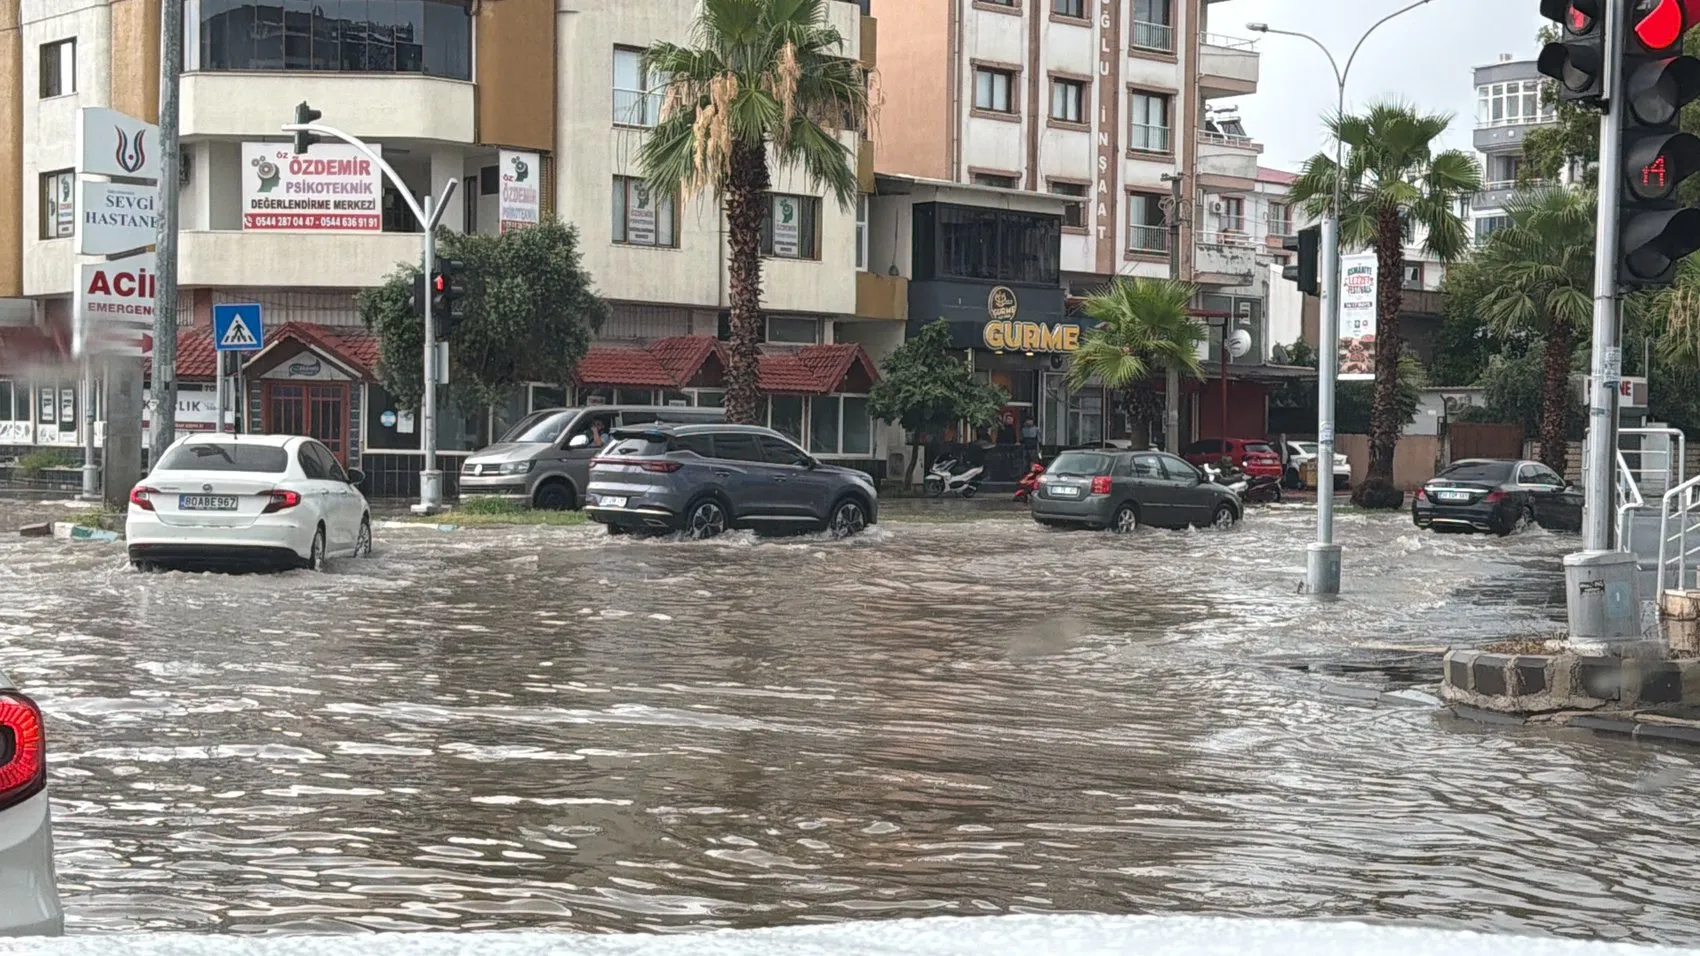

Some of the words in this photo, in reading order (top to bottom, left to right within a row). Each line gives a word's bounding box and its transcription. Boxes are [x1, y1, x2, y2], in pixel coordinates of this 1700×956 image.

[276, 151, 288, 159] ÖZ
[289, 156, 371, 176] ÖZDEMİR
[1097, 105, 1109, 240] İNŞAAT
[286, 180, 373, 194] PSİKOTEKNİK
[106, 195, 154, 210] SEVGİ
[251, 197, 331, 209] DEĞERLENDİRME
[334, 198, 376, 210] MERKEZİ
[86, 211, 158, 228] HASTANE
[256, 216, 277, 226] 0544
[278, 216, 291, 226] 287
[294, 217, 303, 226] 04
[305, 217, 314, 227] 47
[321, 217, 341, 227] 0544
[342, 218, 357, 227] 636
[359, 218, 367, 227] 91
[369, 218, 378, 227] 91
[88, 302, 154, 315] EMERGEN
[983, 320, 1080, 352] GURME
